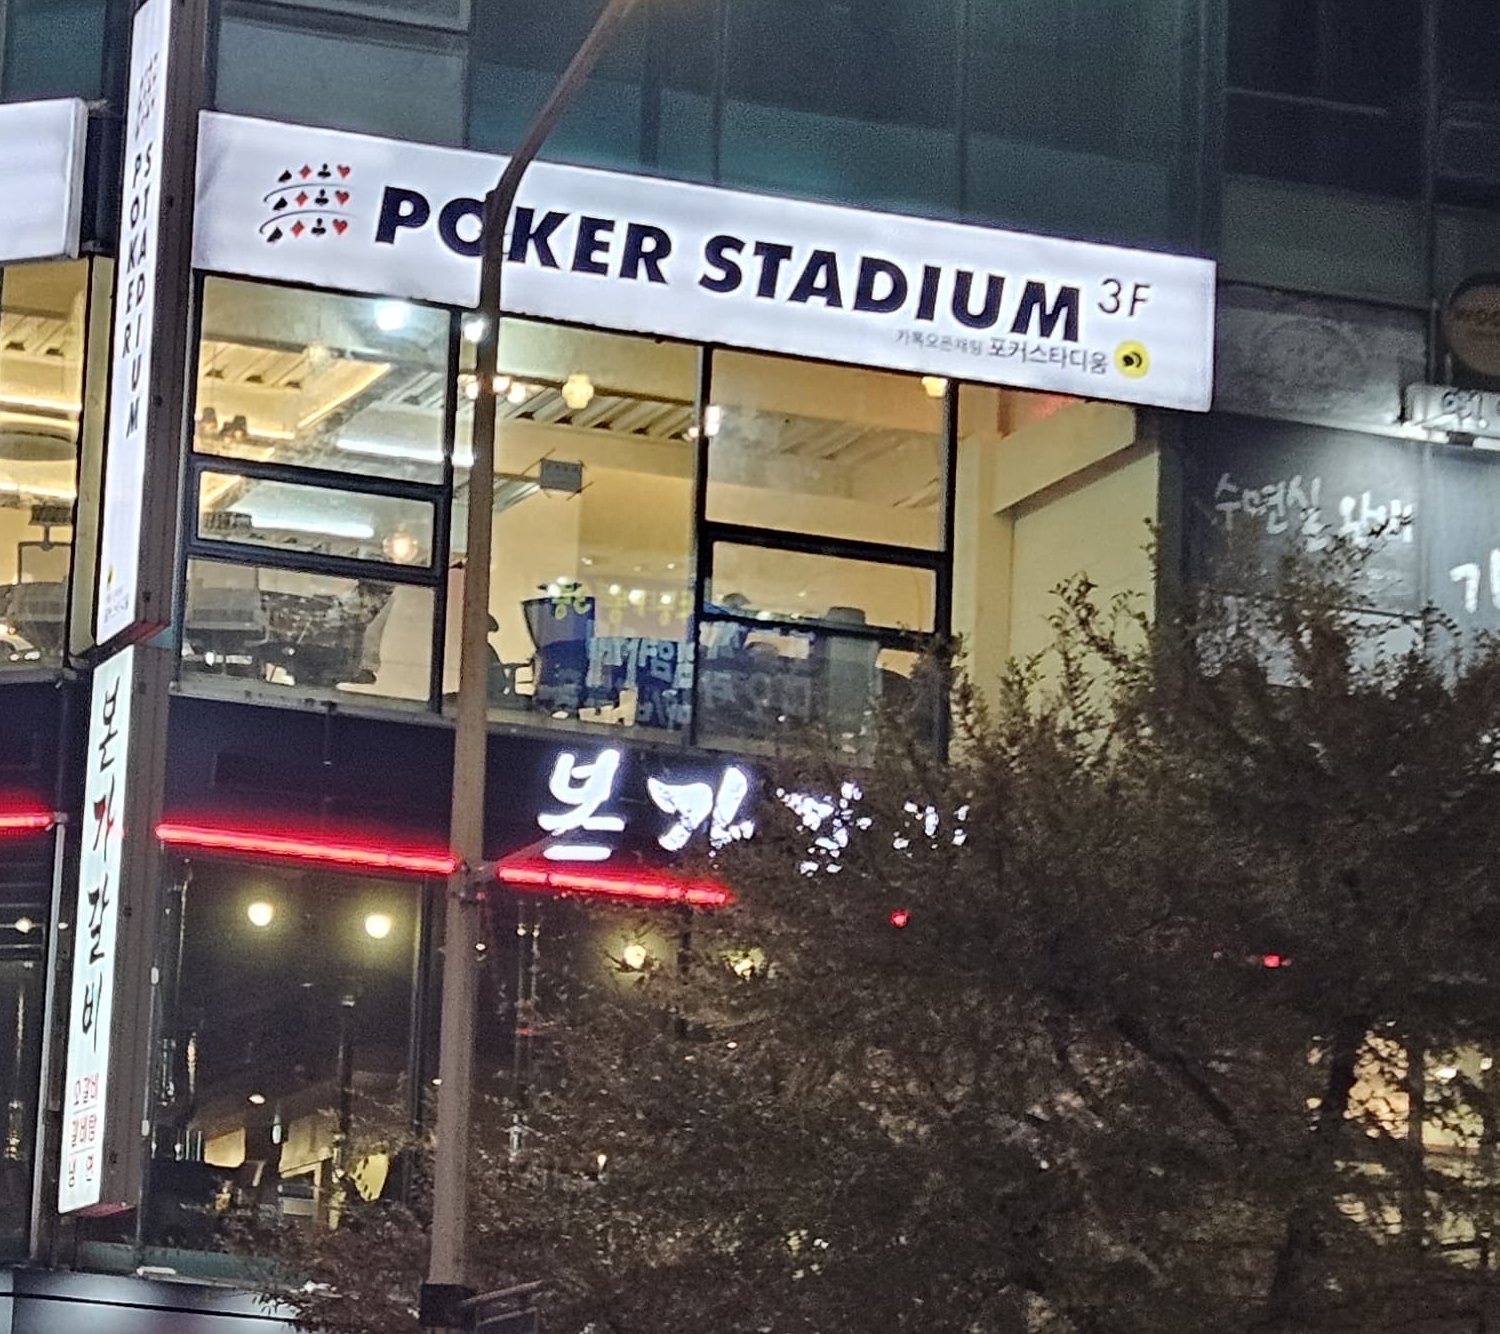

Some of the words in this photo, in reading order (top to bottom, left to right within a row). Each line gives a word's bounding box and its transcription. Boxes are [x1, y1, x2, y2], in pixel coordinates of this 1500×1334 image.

[120, 154, 143, 359] POKER
[126, 140, 154, 439] STADIUM
[374, 185, 671, 287] POKER
[697, 235, 1082, 343] STADIUM
[1097, 276, 1150, 318] 3F
[987, 336, 1108, 376] 포커스타디움
[83, 674, 124, 1055] 본가갈비
